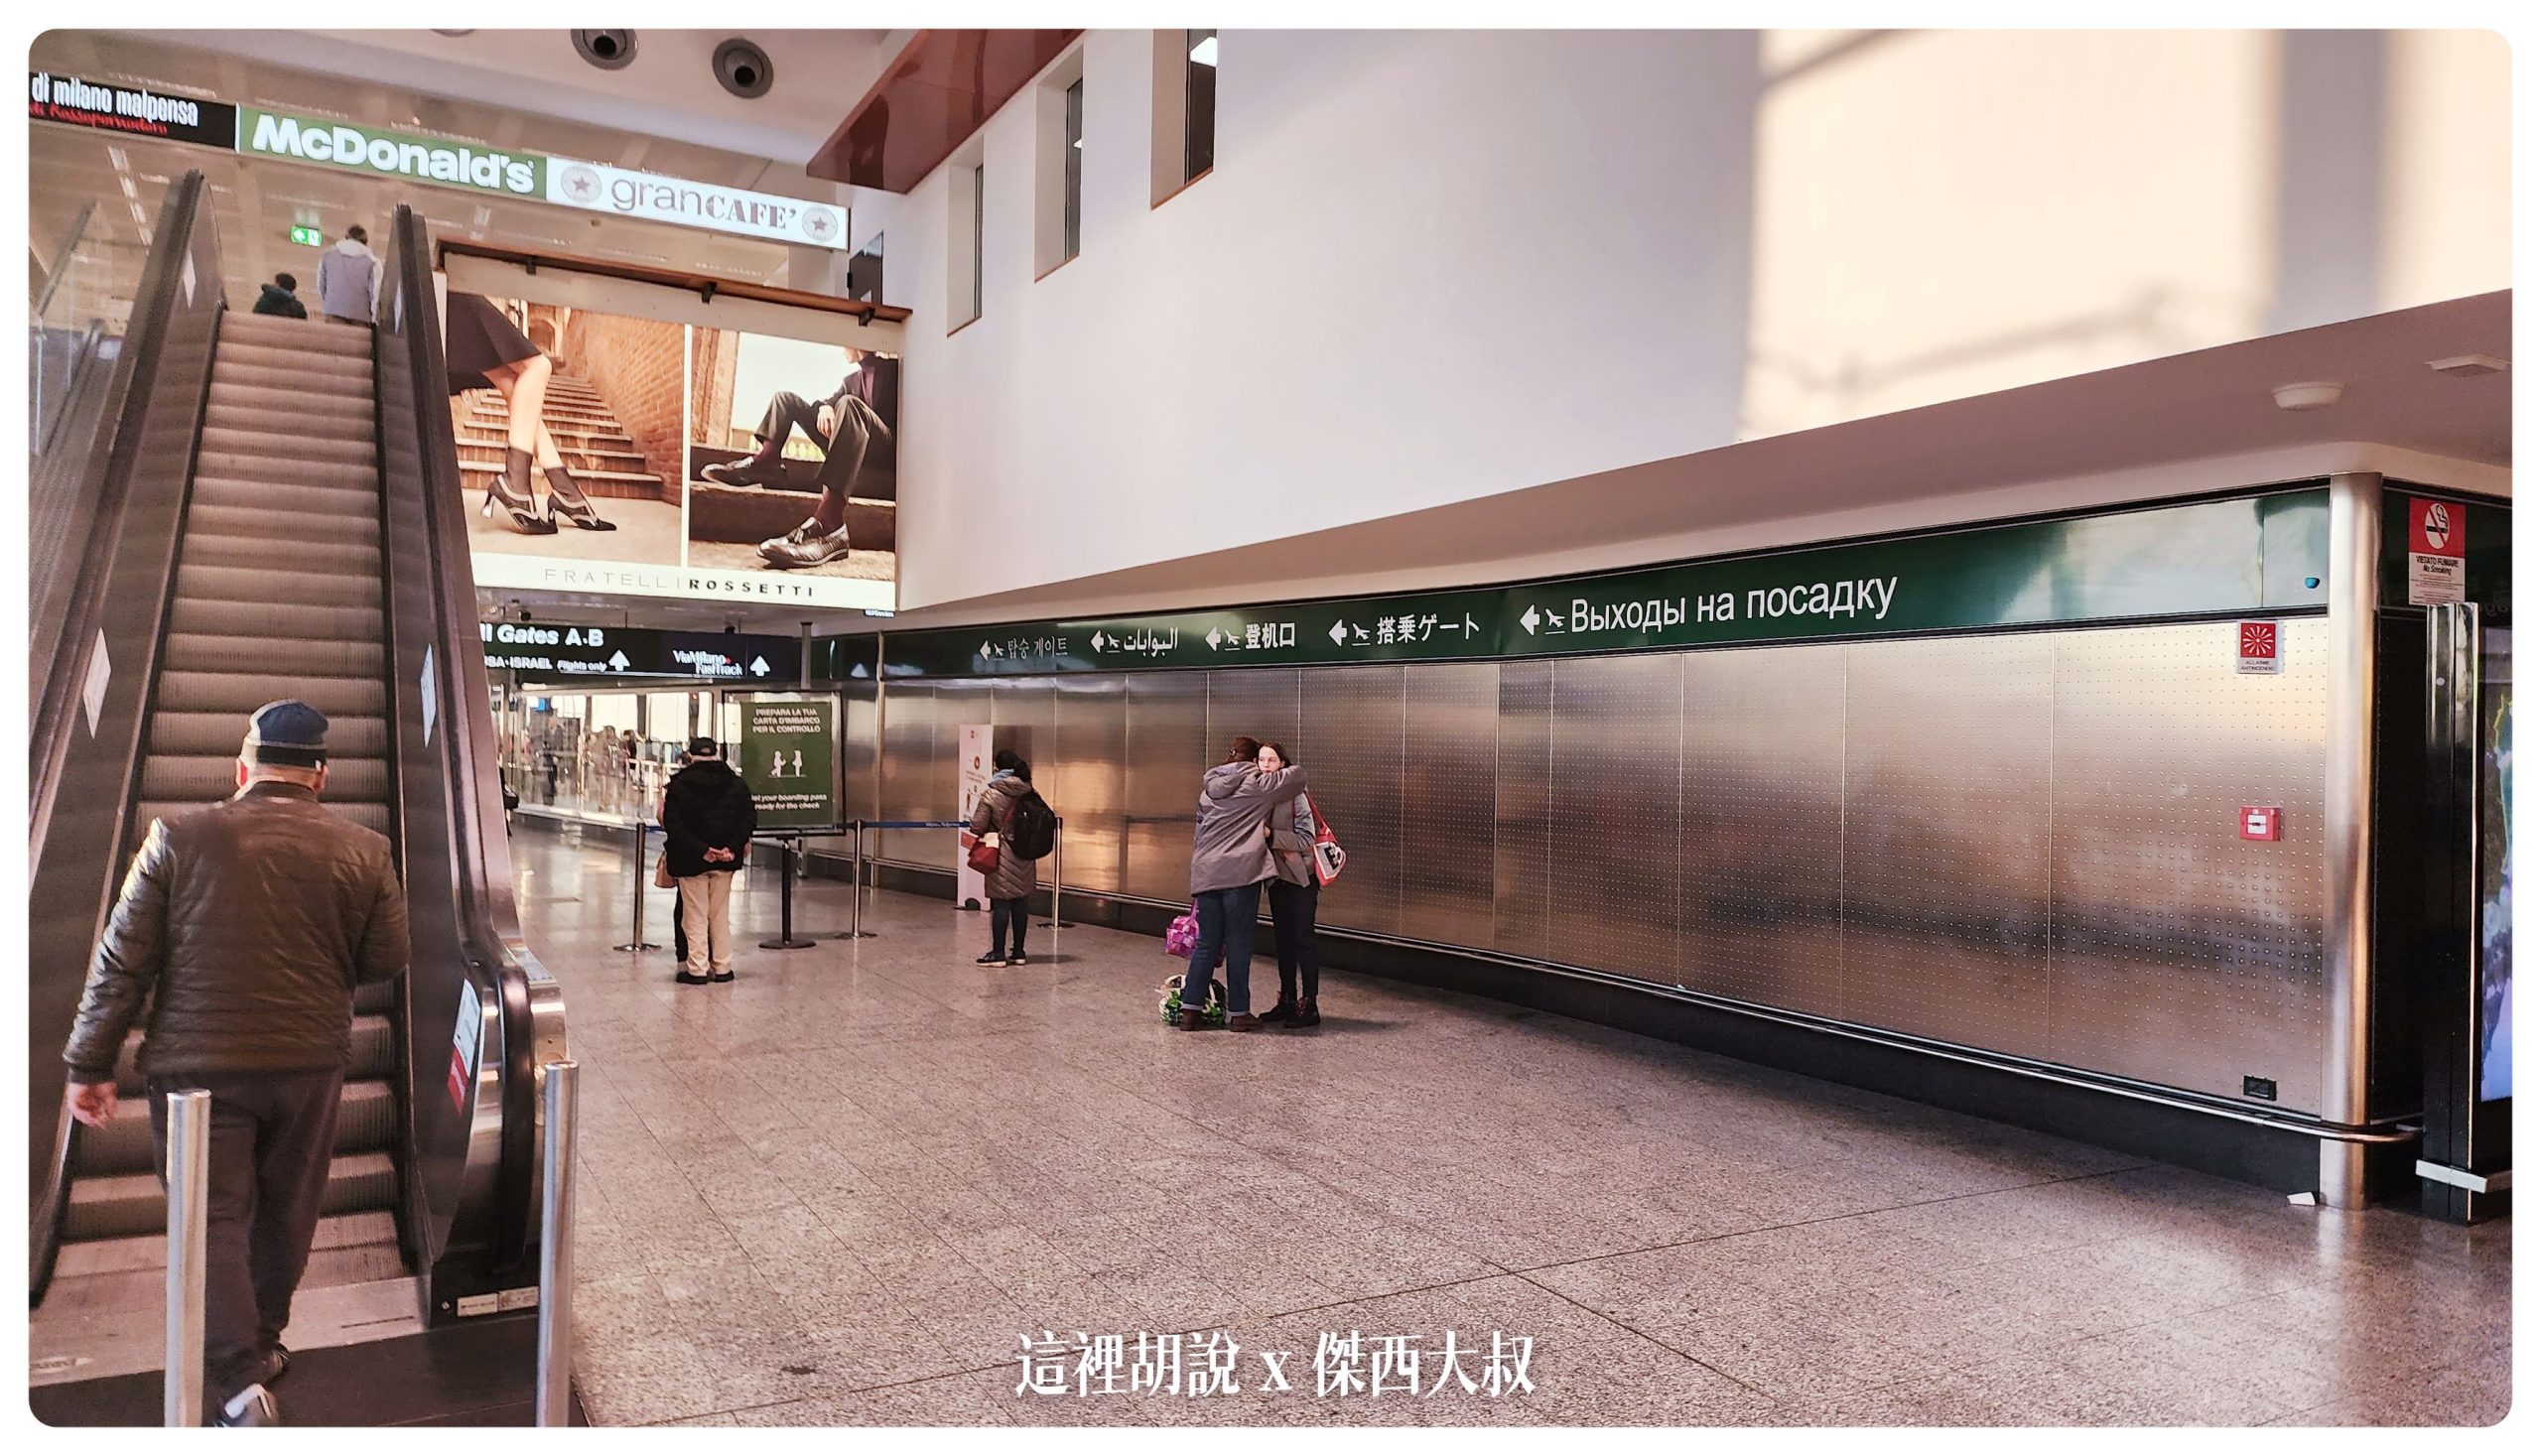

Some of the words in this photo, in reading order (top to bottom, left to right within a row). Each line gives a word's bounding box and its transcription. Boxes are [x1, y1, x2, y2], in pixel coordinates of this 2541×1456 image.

[32, 71, 50, 103] di
[54, 77, 112, 113] milano
[116, 89, 199, 127] malpensa
[252, 114, 535, 194] McDonald's
[545, 569, 681, 589] FRATELLI
[689, 580, 813, 596] ROSSETTI
[1571, 597, 1686, 634] Выходы
[1696, 593, 1735, 623] на
[1747, 576, 1899, 620] посадку
[479, 622, 493, 642] ll
[497, 623, 560, 645] Gates
[1124, 626, 1179, 658] البوابات
[1245, 622, 1296, 650] 登机口
[1377, 611, 1481, 646] 搭乗ゲート
[1007, 637, 1029, 660] 탑승
[1033, 635, 1069, 658] 게이트
[588, 661, 607, 673] only
[753, 717, 778, 726] CARTA
